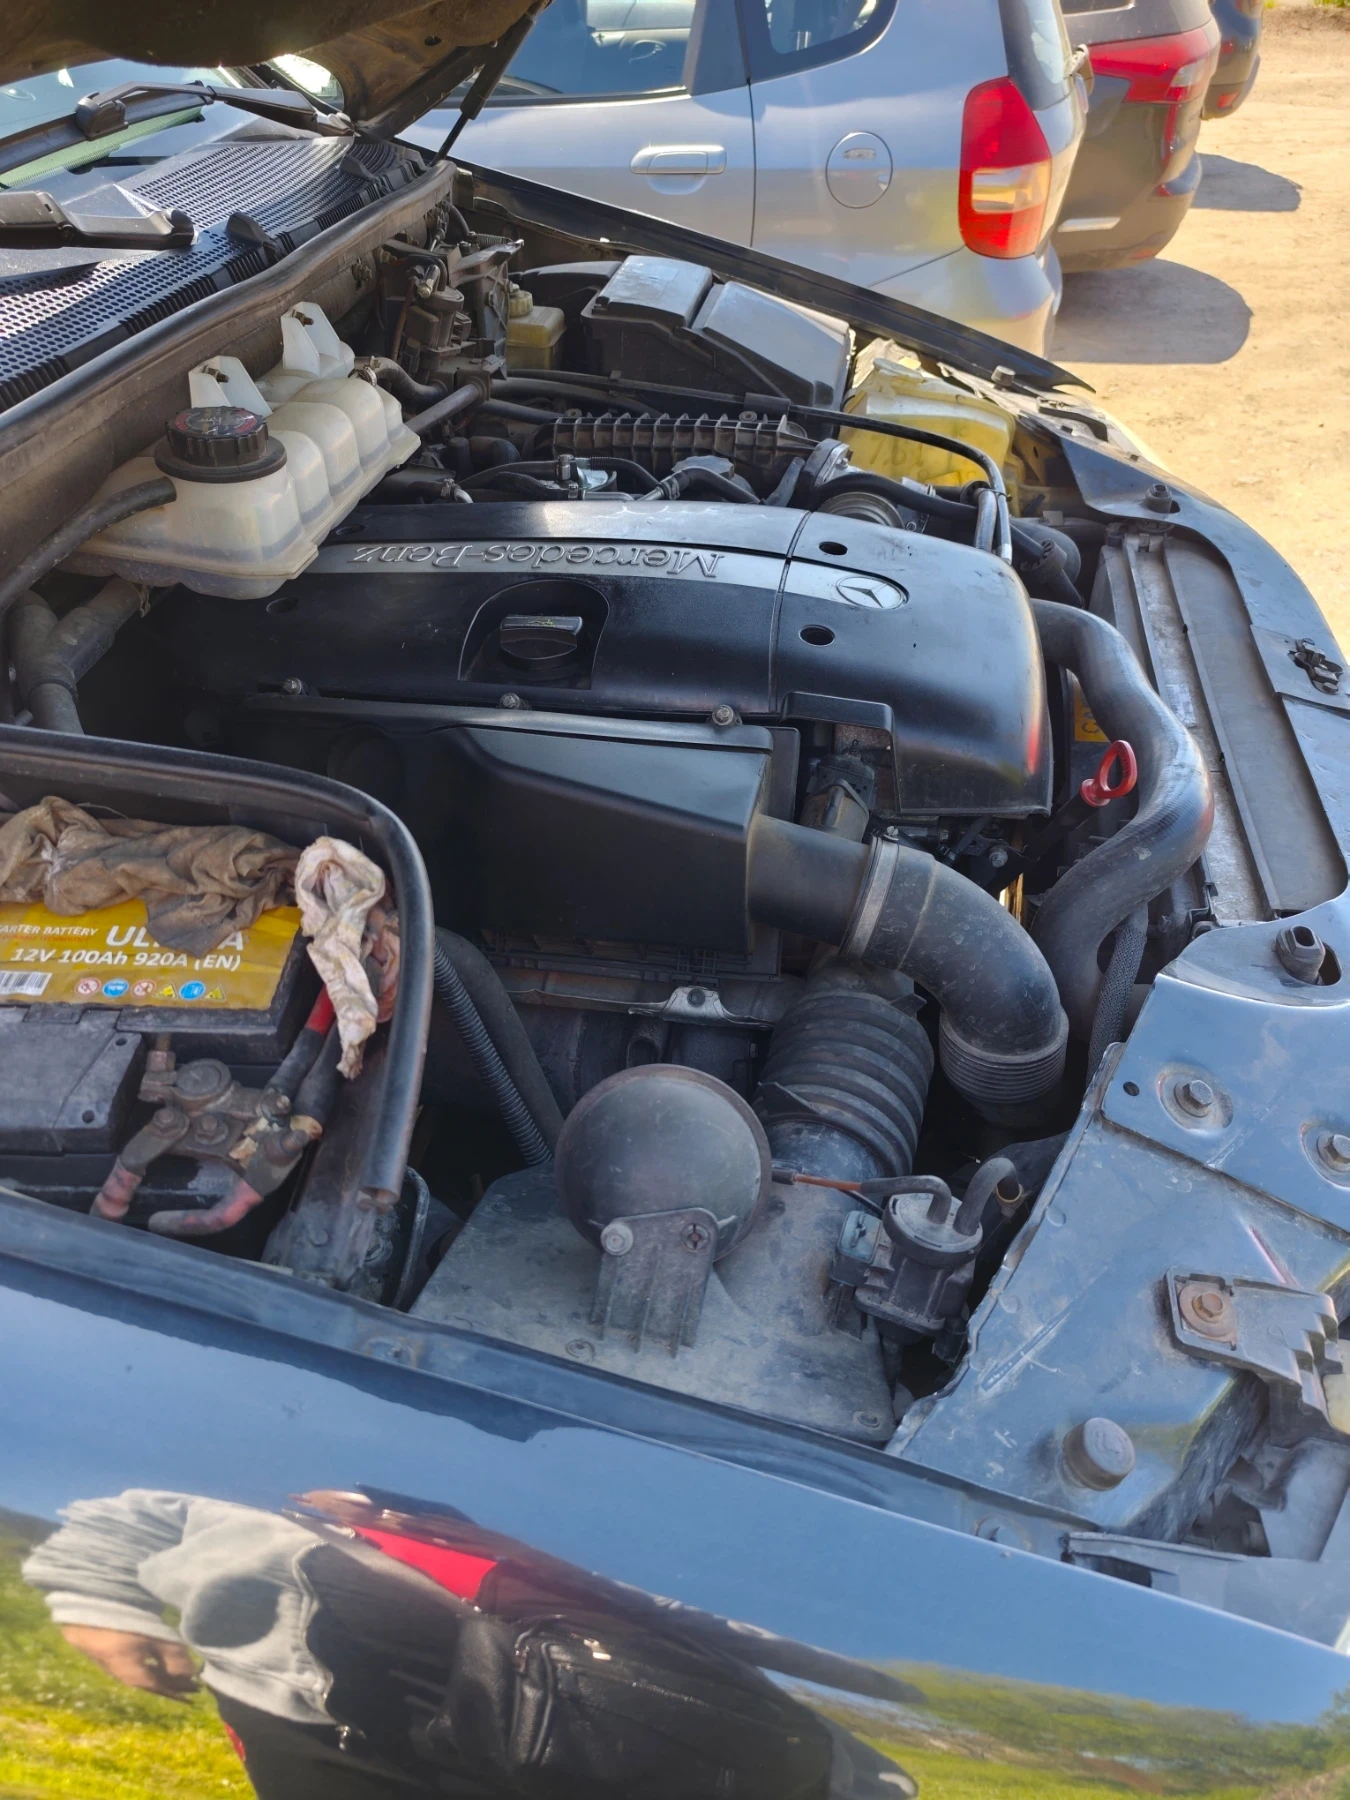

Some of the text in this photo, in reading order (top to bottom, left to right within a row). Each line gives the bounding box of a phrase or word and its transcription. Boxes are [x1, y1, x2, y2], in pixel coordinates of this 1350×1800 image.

[349, 544, 724, 578] Mercedes-Benz
[0, 924, 99, 936] ARTER BATTERY
[106, 925, 244, 951] ULA
[10, 948, 241, 972] 12V 100Ah 920A (EN)
